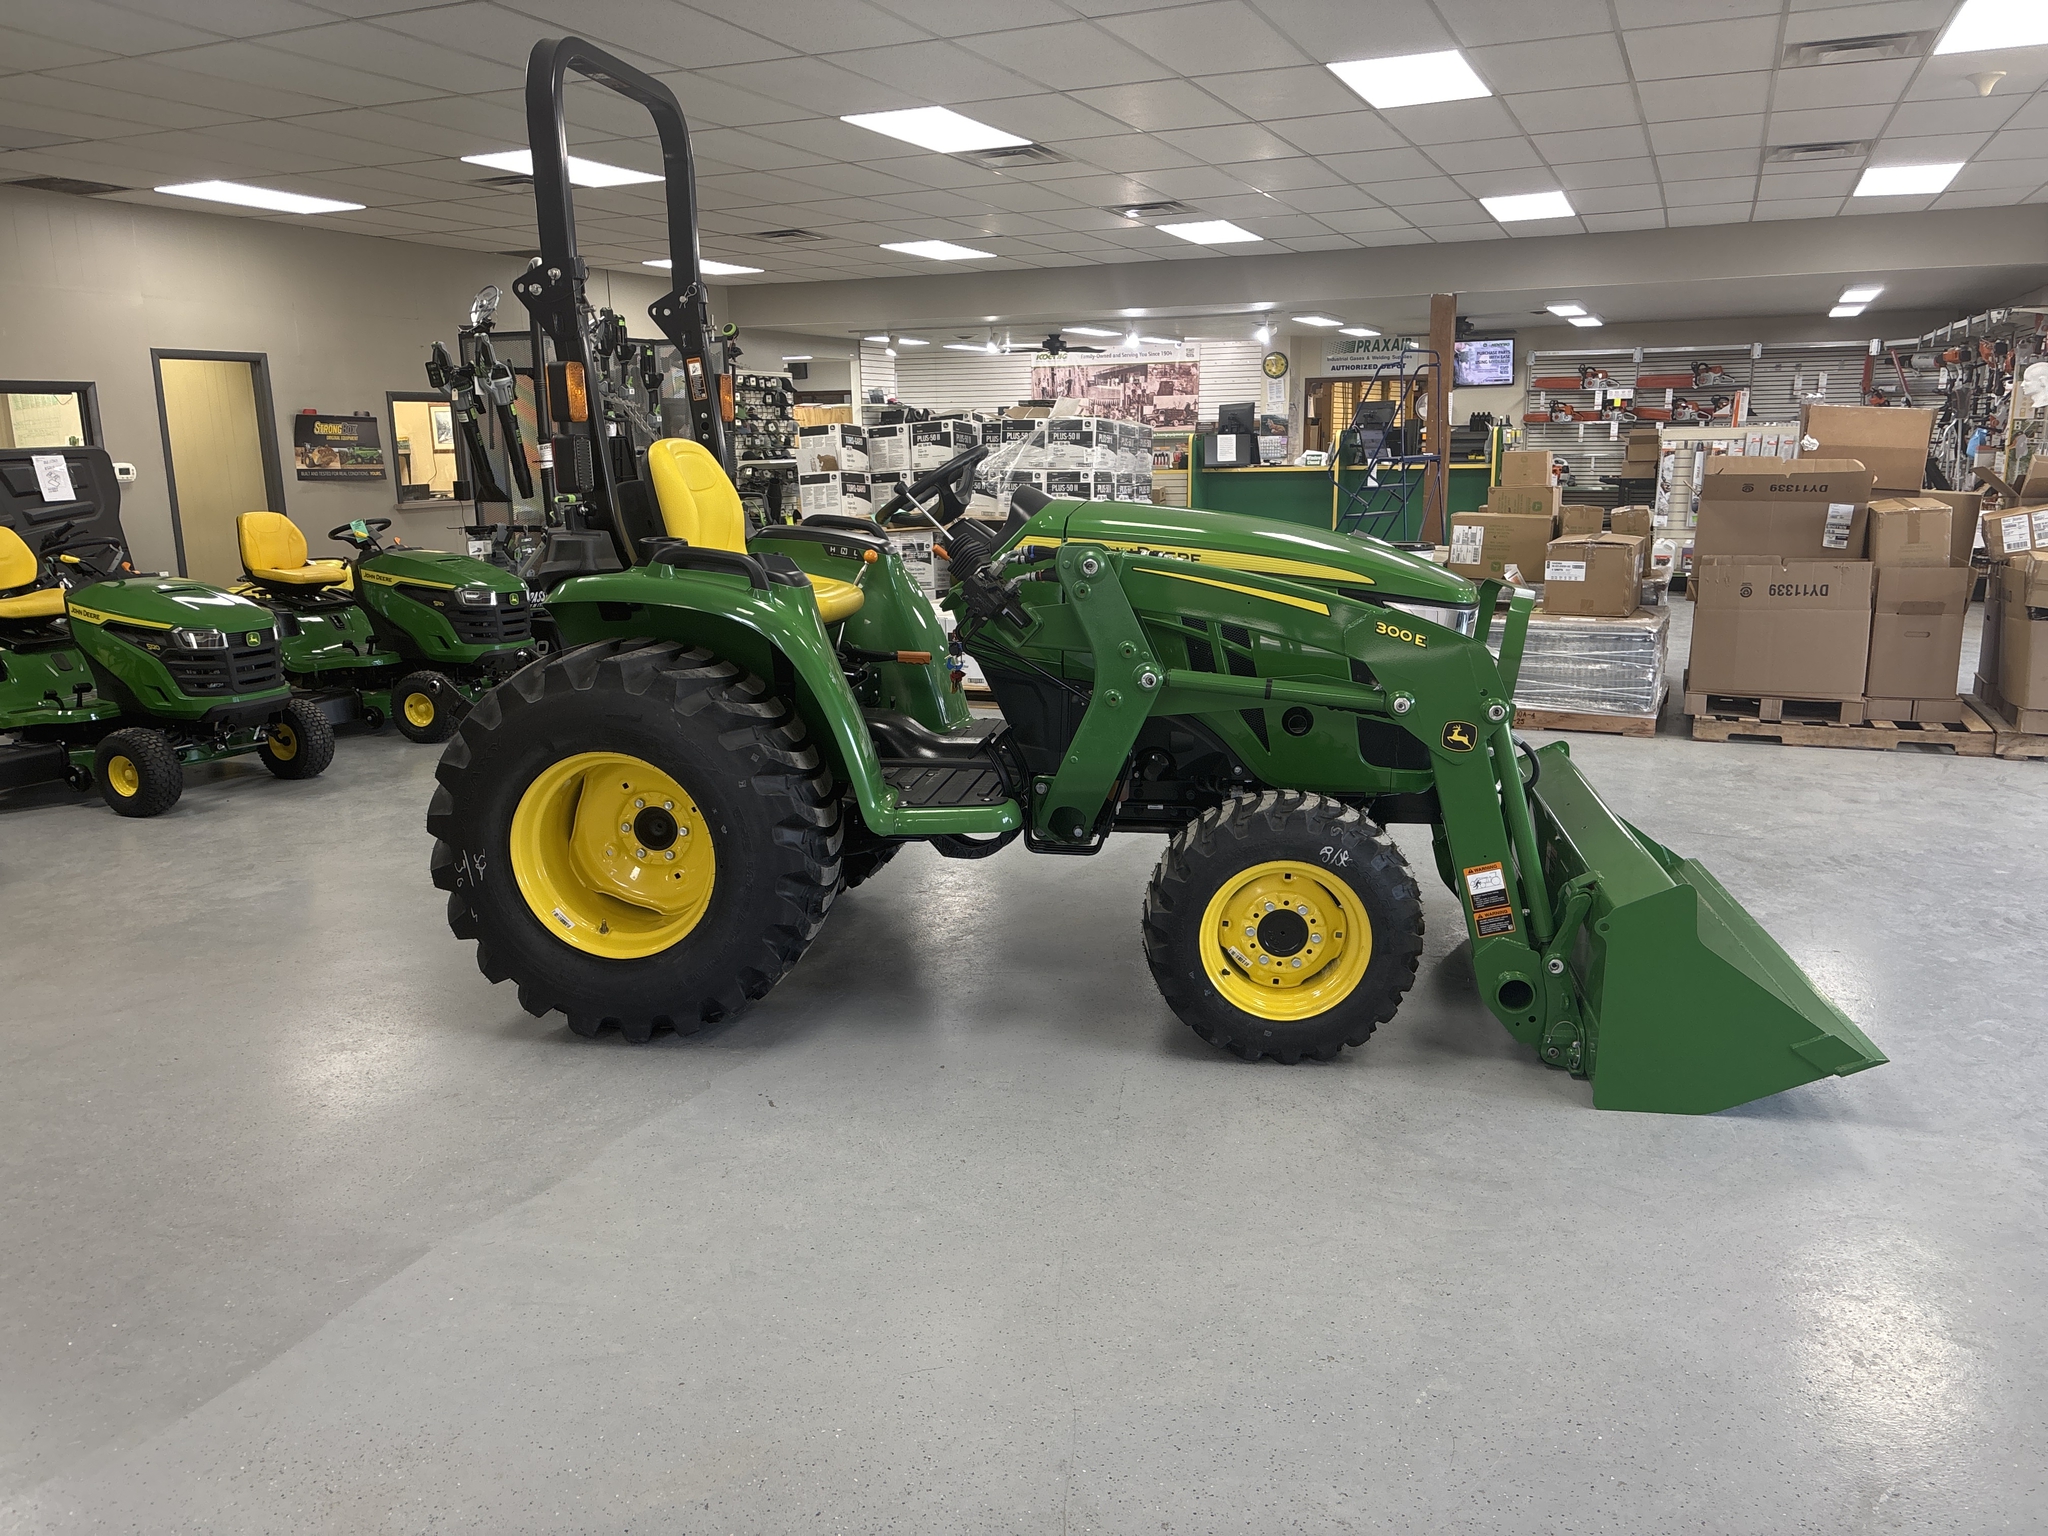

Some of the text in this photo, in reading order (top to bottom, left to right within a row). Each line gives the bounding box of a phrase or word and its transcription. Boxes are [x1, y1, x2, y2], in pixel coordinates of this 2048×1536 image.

[1356, 338, 1412, 353] PRAXAIR
[916, 434, 936, 442] PLUS-50
[1770, 484, 1828, 492] DY11339
[1769, 584, 1829, 596] DY11339
[82, 610, 100, 620] DEERE
[1376, 622, 1426, 648] 300E
[1474, 864, 1498, 872] WARNING
[1484, 909, 1508, 918] WARNING
